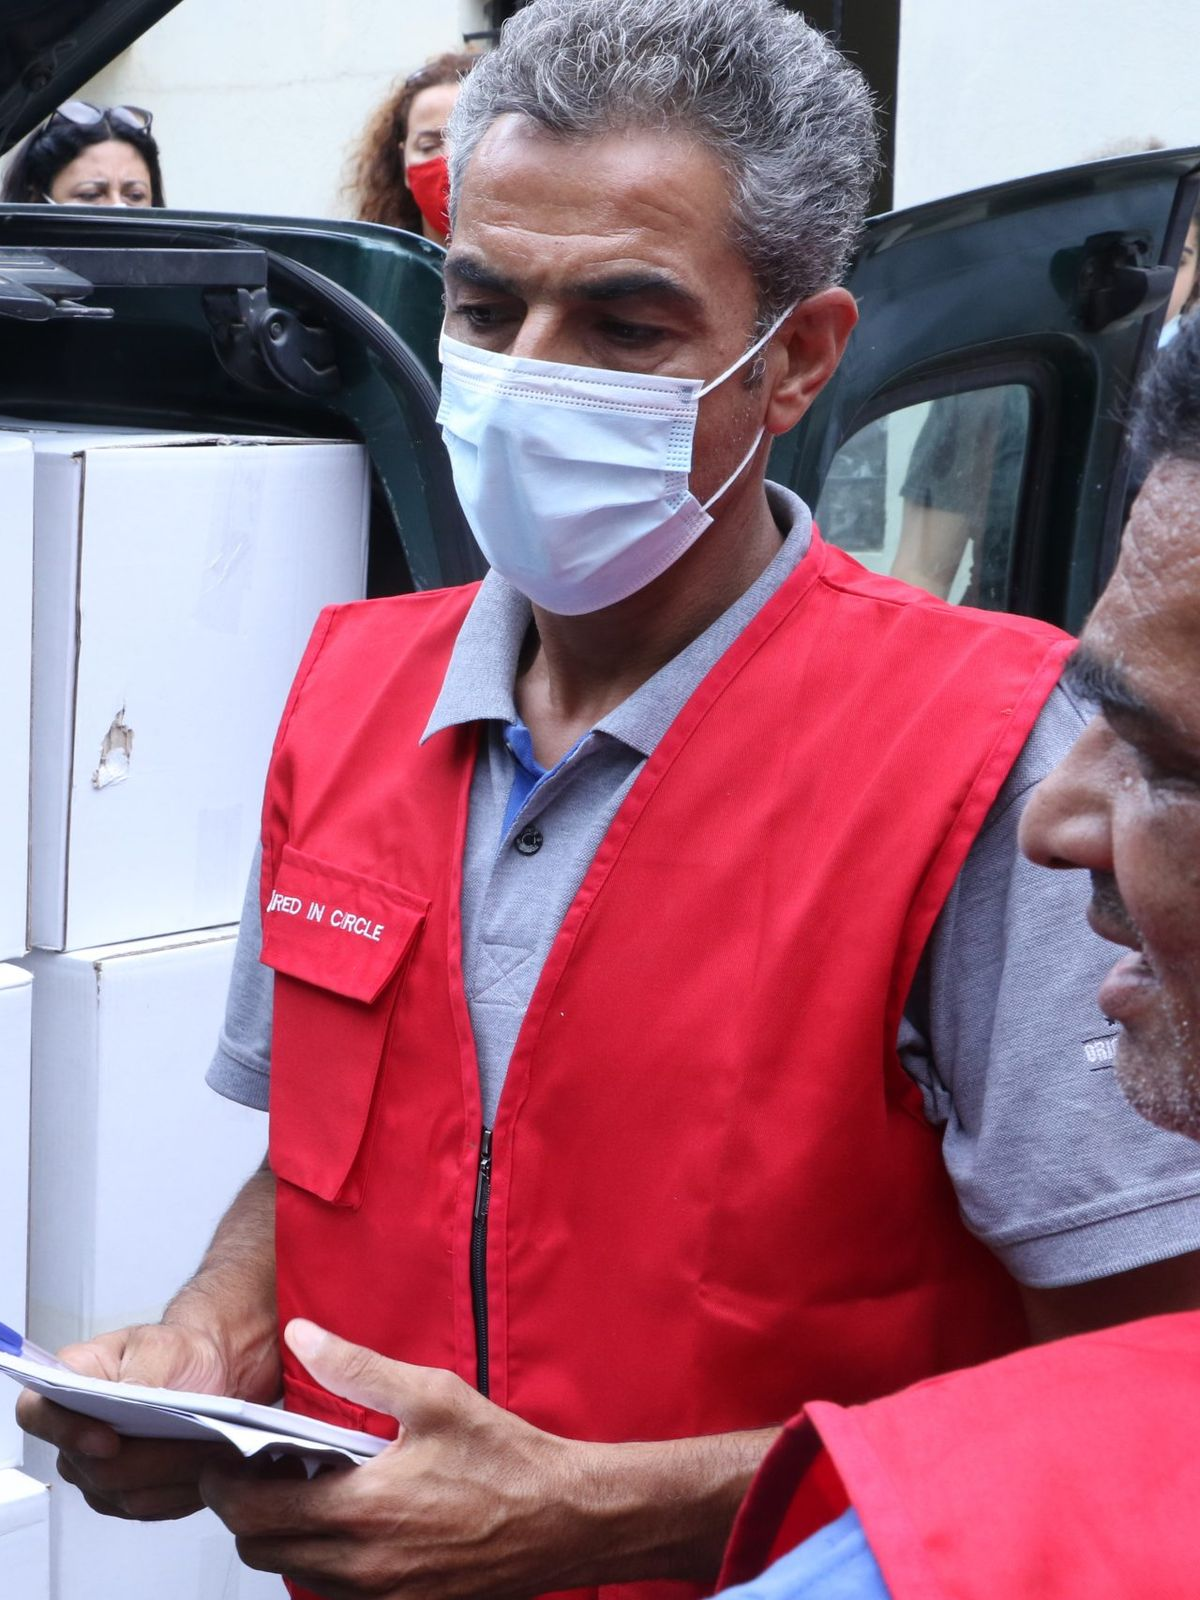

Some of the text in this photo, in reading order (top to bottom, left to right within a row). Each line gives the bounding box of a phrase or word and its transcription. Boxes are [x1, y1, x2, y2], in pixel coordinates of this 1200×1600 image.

[270, 893, 384, 941] RED IN CIRCLE
